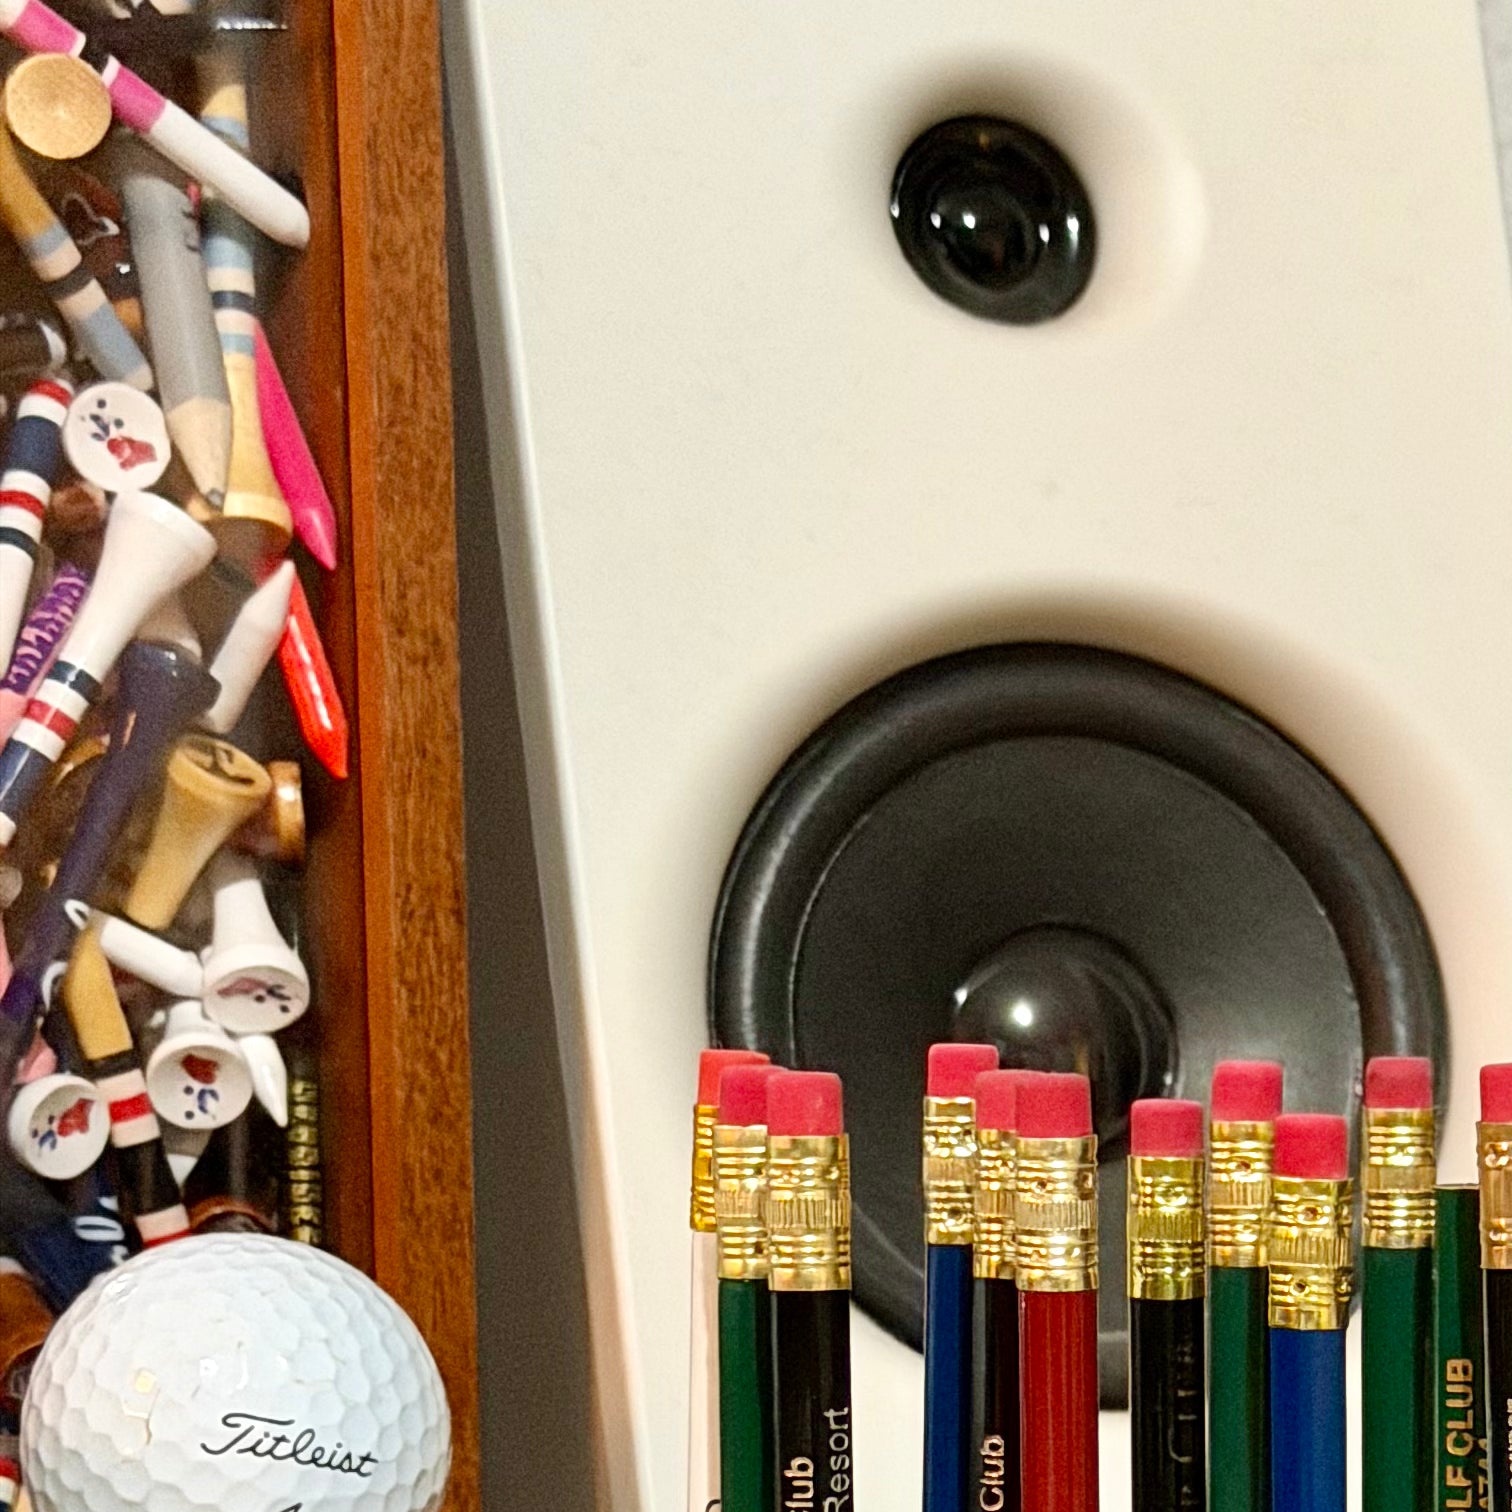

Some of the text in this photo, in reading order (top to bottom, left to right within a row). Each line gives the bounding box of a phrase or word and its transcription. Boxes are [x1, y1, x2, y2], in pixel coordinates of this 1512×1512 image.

[201, 1412, 379, 1479] Titleist
[1445, 1357, 1474, 1457] CLUB
[978, 1434, 1006, 1512] Club
